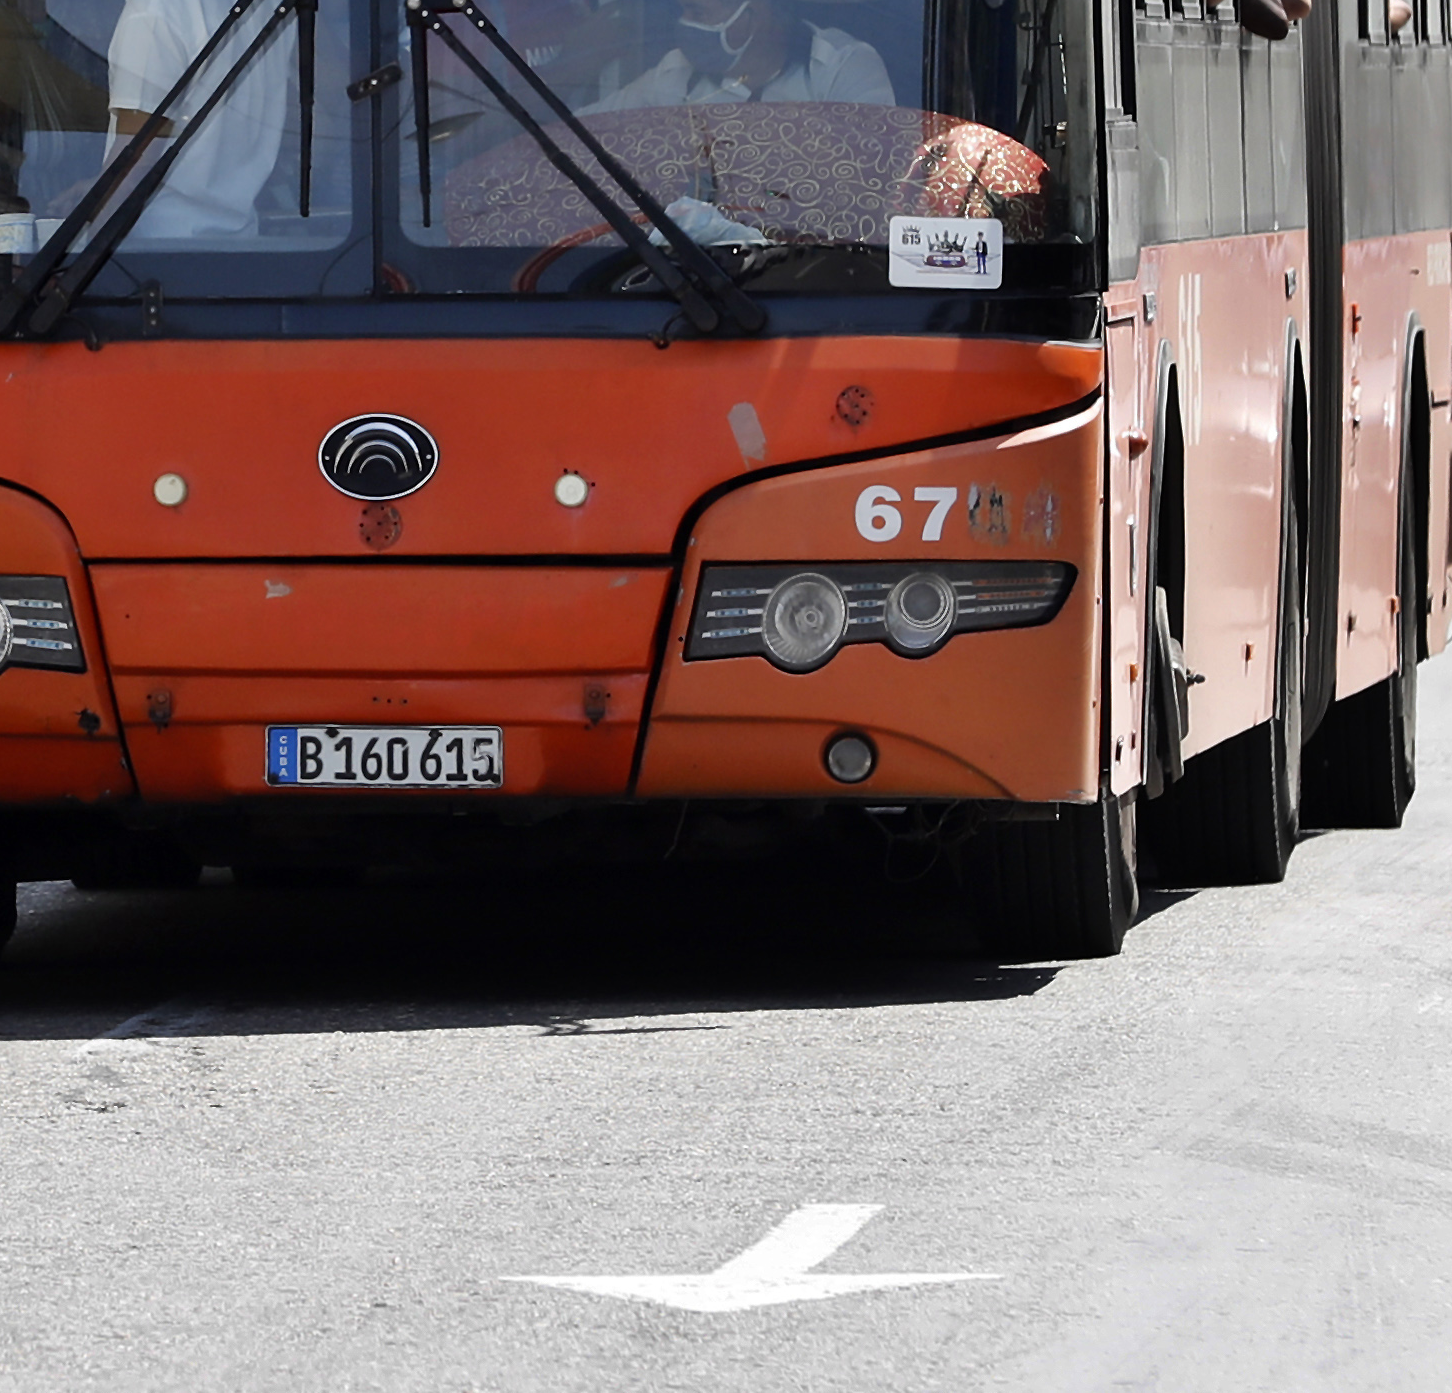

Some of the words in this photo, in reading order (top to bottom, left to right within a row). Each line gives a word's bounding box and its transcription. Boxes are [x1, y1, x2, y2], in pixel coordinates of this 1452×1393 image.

[901, 233, 921, 245] 615
[1178, 273, 1202, 446] 615
[279, 735, 288, 777] CUBA
